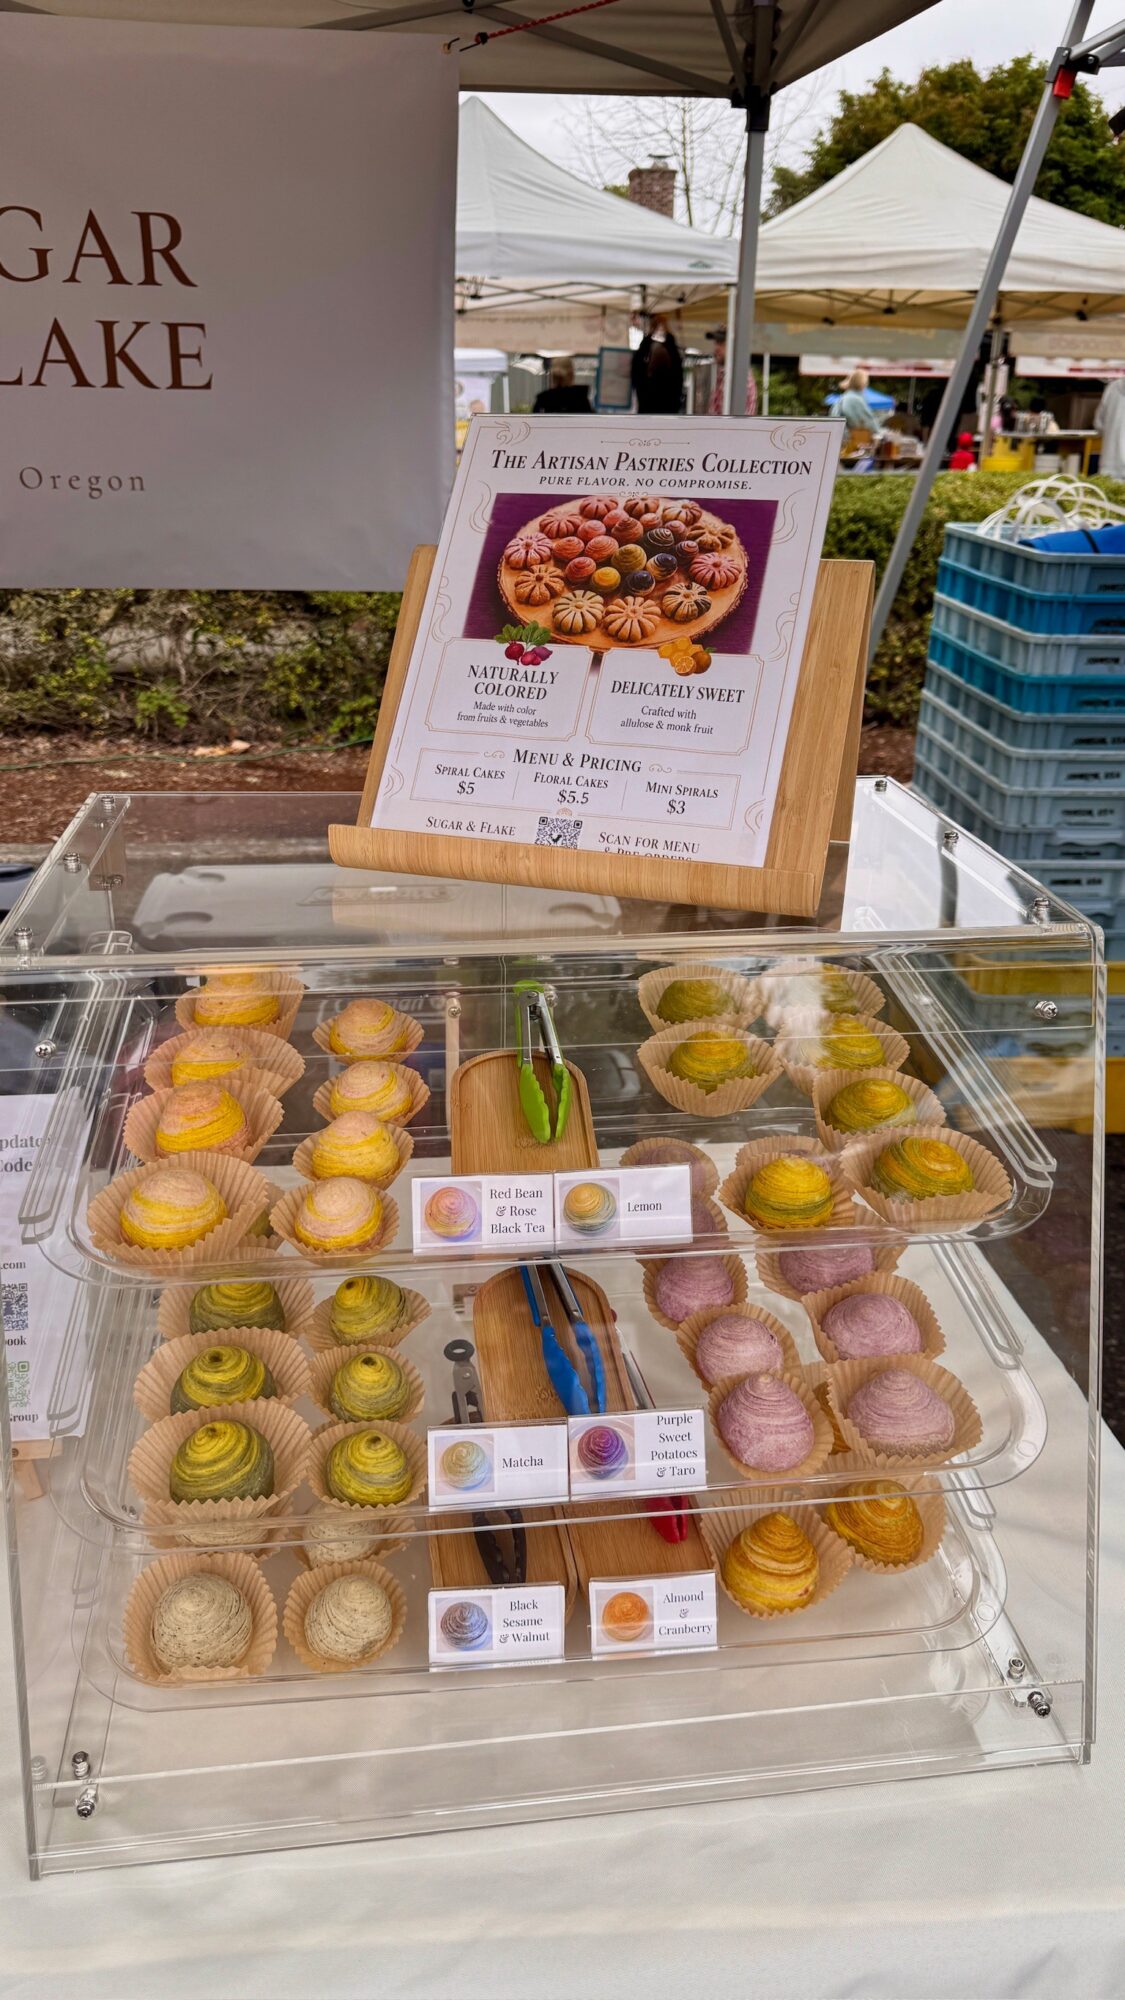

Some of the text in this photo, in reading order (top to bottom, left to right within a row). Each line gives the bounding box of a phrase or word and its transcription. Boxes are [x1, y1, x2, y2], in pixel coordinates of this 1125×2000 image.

[0, 205, 199, 288] GAR
[18, 466, 146, 500] Oregon
[539, 475, 752, 490] PURE FLAVOR. NO COMPROMISE.
[467, 664, 559, 685] NATURALLY
[474, 682, 547, 701] COLORED
[611, 679, 745, 703] DELICATELY SWEET
[473, 700, 536, 715] Made with color
[640, 705, 697, 720] Crafted with
[457, 712, 549, 729] from fruits & vegetables
[620, 717, 714, 735] allulose & monk fruit
[562, 752, 574, 767] &
[456, 780, 476, 796] $5
[557, 789, 589, 805] $5.5
[666, 799, 686, 815] $3
[466, 821, 476, 832] &
[635, 836, 659, 850] FOR
[662, 839, 700, 854] MENU
[0, 1135, 51, 1151] pdate
[0, 1157, 33, 1173] ode
[489, 1187, 543, 1200] Red Bean
[496, 1205, 537, 1216] & Rose
[627, 1200, 662, 1212] Lemon
[490, 1222, 545, 1234] Black Tea
[656, 1412, 693, 1427] Purple
[658, 1431, 692, 1443] Sweet
[502, 1455, 544, 1469] Matcha
[651, 1448, 698, 1461] Potatoes
[656, 1464, 696, 1478] & Taro
[663, 1591, 704, 1604] Almond
[509, 1600, 538, 1612] Black
[679, 1607, 689, 1619] &
[502, 1616, 543, 1628] Sesame
[658, 1622, 713, 1636] Cranberry
[499, 1629, 550, 1644] & Walnut
